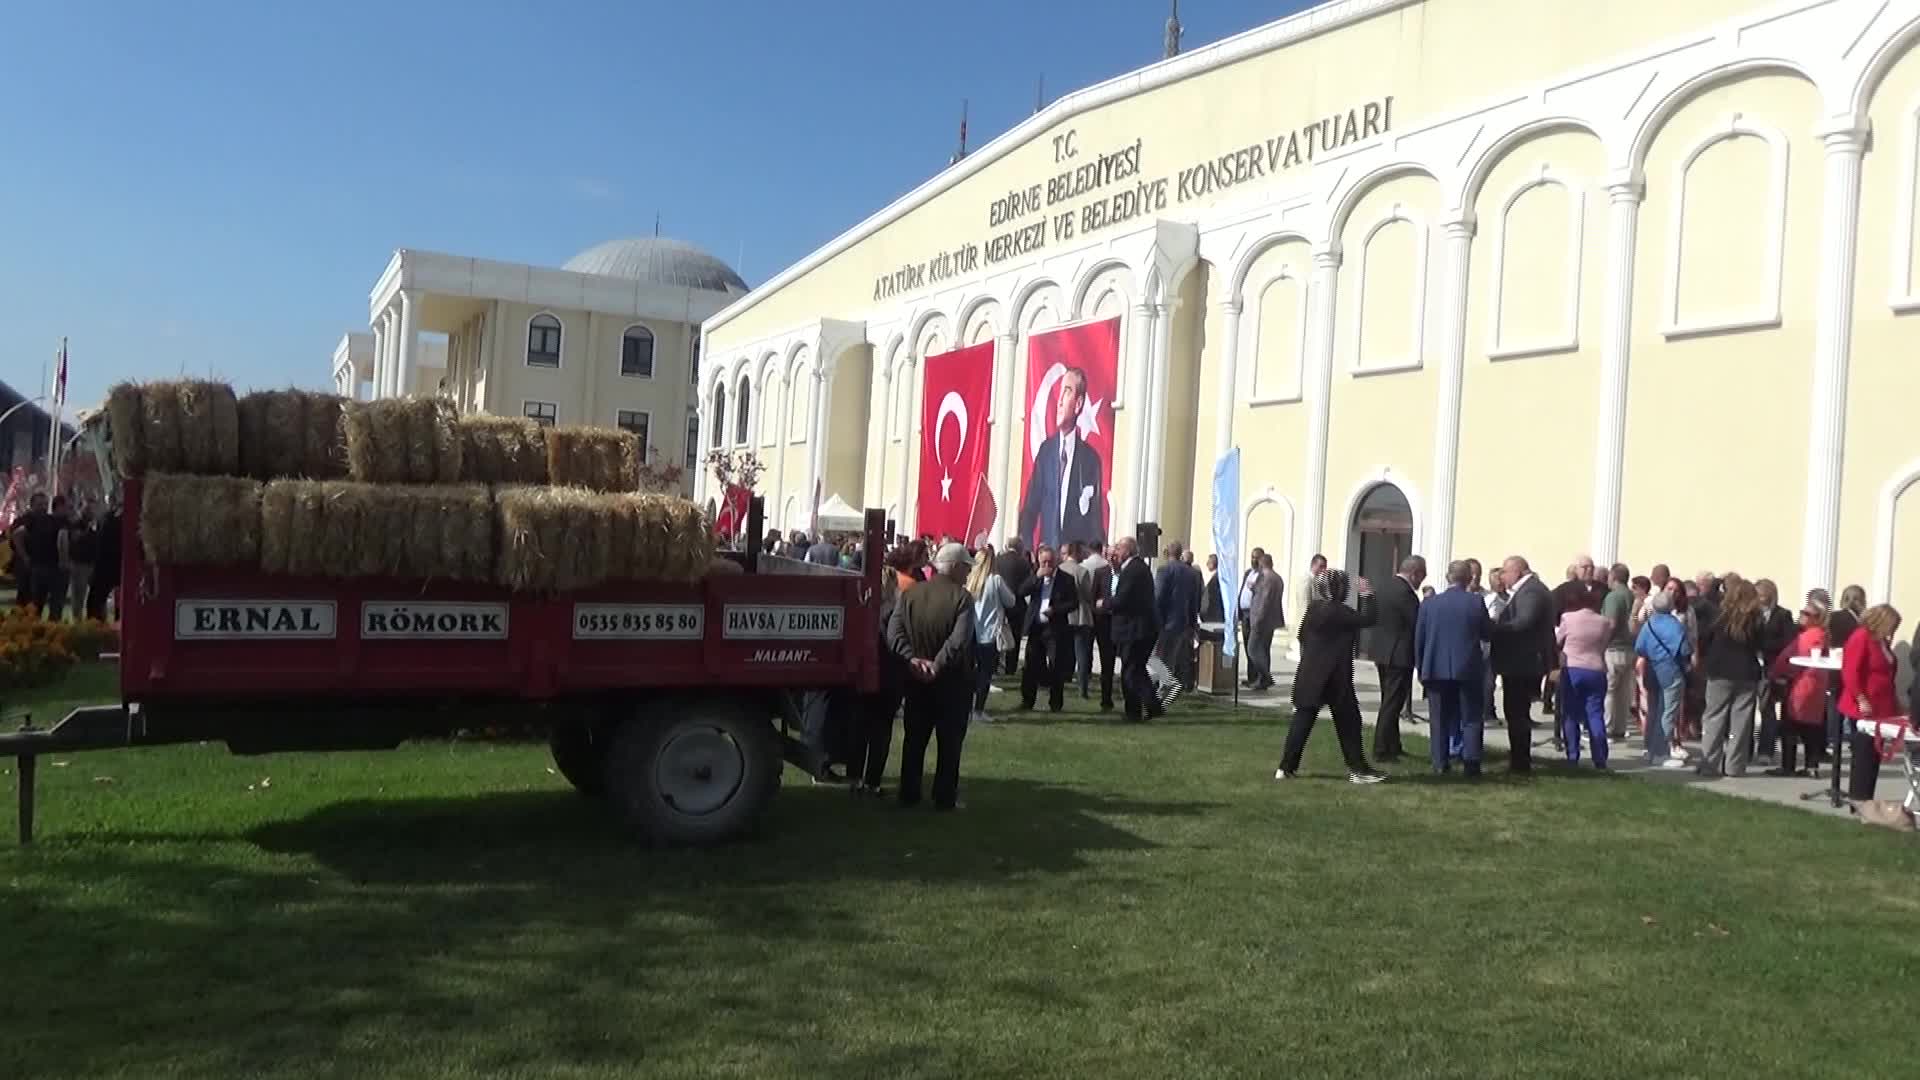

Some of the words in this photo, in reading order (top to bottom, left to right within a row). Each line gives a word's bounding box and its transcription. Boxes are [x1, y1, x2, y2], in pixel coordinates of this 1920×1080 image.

[990, 184, 1042, 228] EDİRNE
[1047, 137, 1142, 206] BELEDİYESİ
[873, 263, 926, 301] ATATÜRK
[929, 242, 978, 283] KÜLTÜR
[984, 215, 1047, 266] MERKEZİ
[1054, 211, 1076, 241] VE
[1081, 177, 1169, 234] BELEDİYE
[1177, 95, 1394, 203] KONSERVATUARI
[193, 607, 321, 632] ERNAL
[367, 607, 502, 632] RÖMORK
[579, 613, 618, 631] 0535
[622, 612, 651, 631] 835
[655, 612, 674, 631] 85
[678, 612, 697, 630] 80
[728, 612, 775, 630] HAVSA
